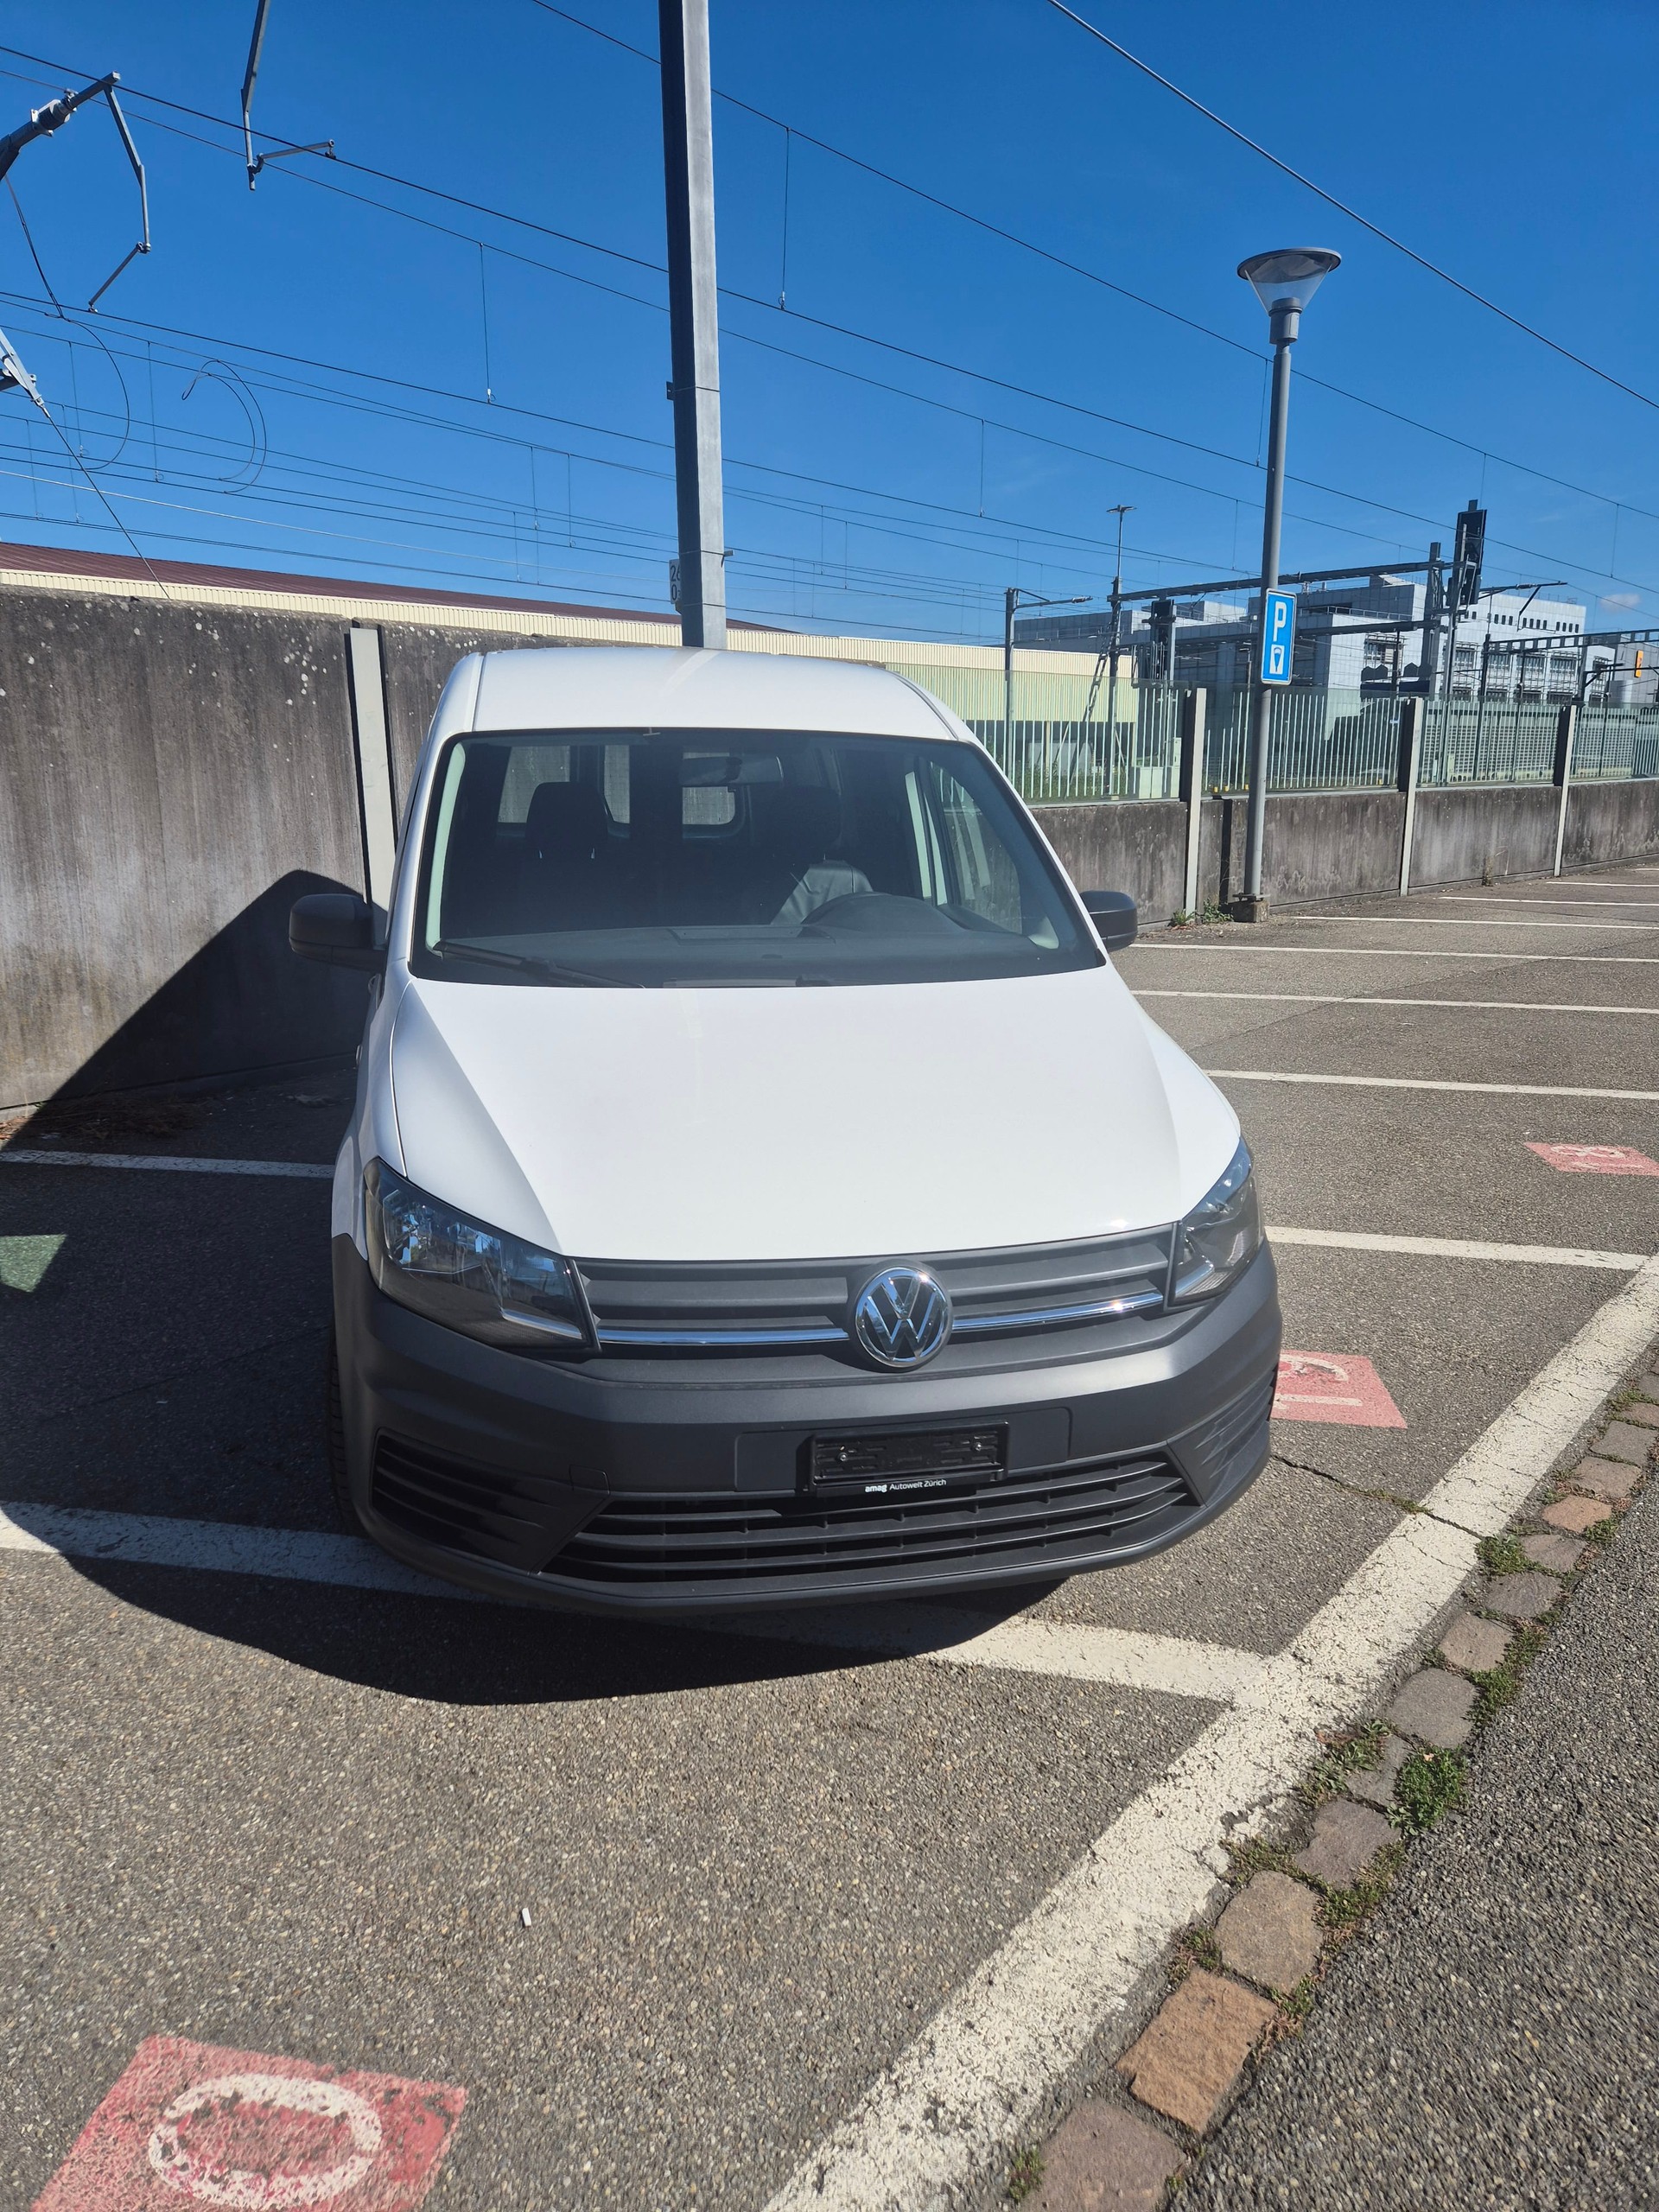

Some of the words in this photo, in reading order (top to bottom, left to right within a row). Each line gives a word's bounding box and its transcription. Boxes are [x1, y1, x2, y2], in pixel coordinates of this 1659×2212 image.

[1273, 601, 1287, 642] P
[857, 1269, 945, 1365] VW
[865, 1484, 887, 1493] amag
[889, 1481, 923, 1491] Autowelt
[924, 1478, 947, 1487] Zürich
